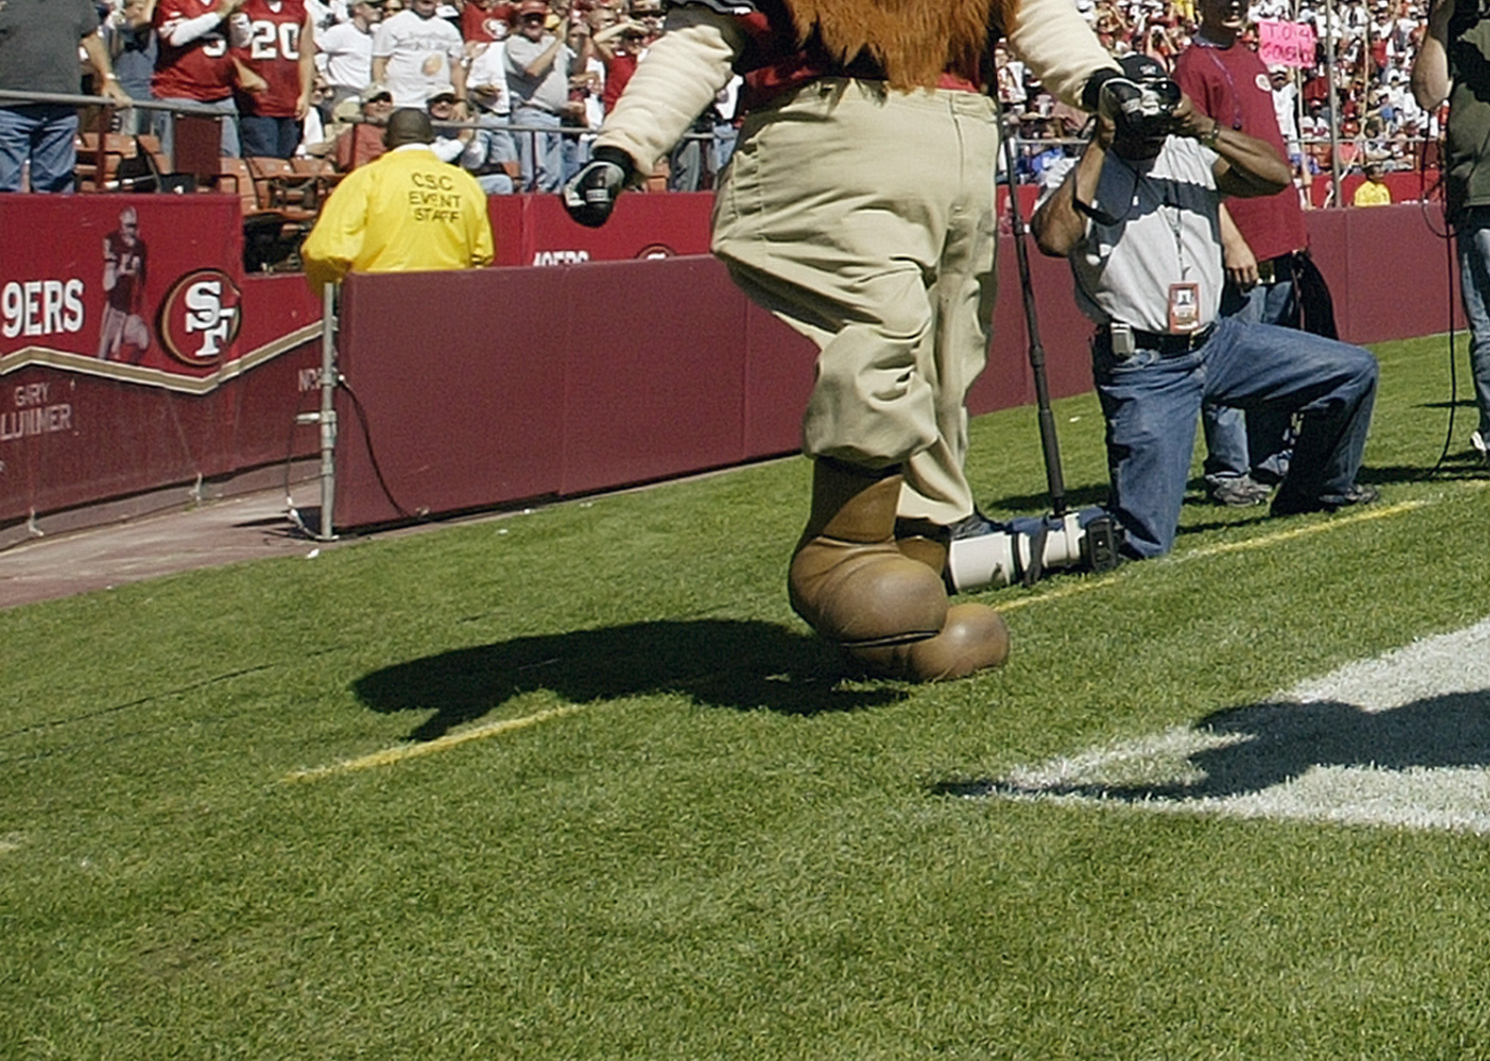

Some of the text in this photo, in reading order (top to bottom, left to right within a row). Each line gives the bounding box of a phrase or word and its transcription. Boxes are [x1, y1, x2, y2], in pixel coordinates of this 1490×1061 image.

[251, 20, 300, 60] 20
[411, 172, 454, 191] CSC
[408, 190, 461, 208] EVENT
[414, 207, 460, 223] STAFF
[185, 281, 236, 356] SF
